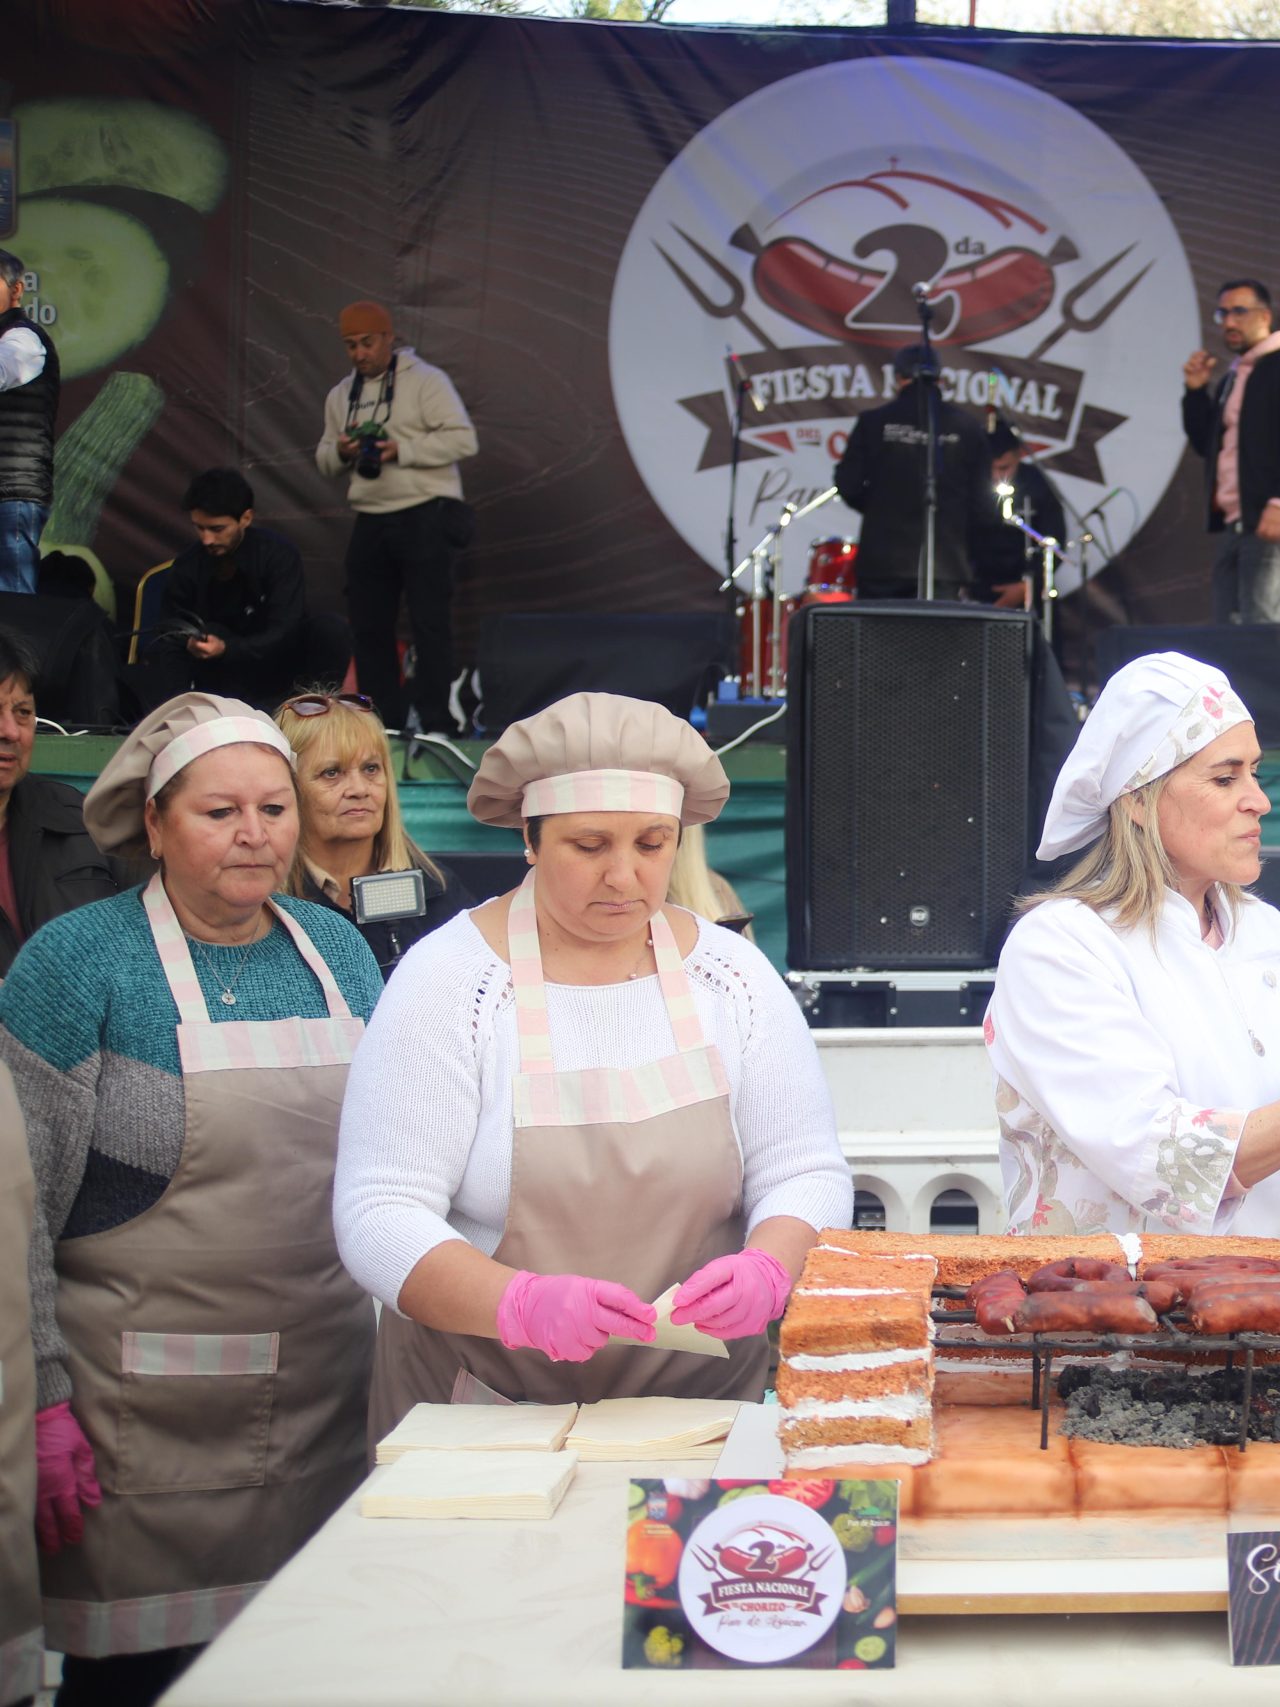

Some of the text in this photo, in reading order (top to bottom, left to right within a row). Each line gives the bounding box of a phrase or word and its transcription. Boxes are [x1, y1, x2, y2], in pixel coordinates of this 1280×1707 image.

[846, 223, 986, 338] 2 da
[750, 364, 1062, 420] FIESTA NCIONAL
[747, 1540, 776, 1573] 2
[718, 1582, 808, 1598] FIESTA NACIONAL
